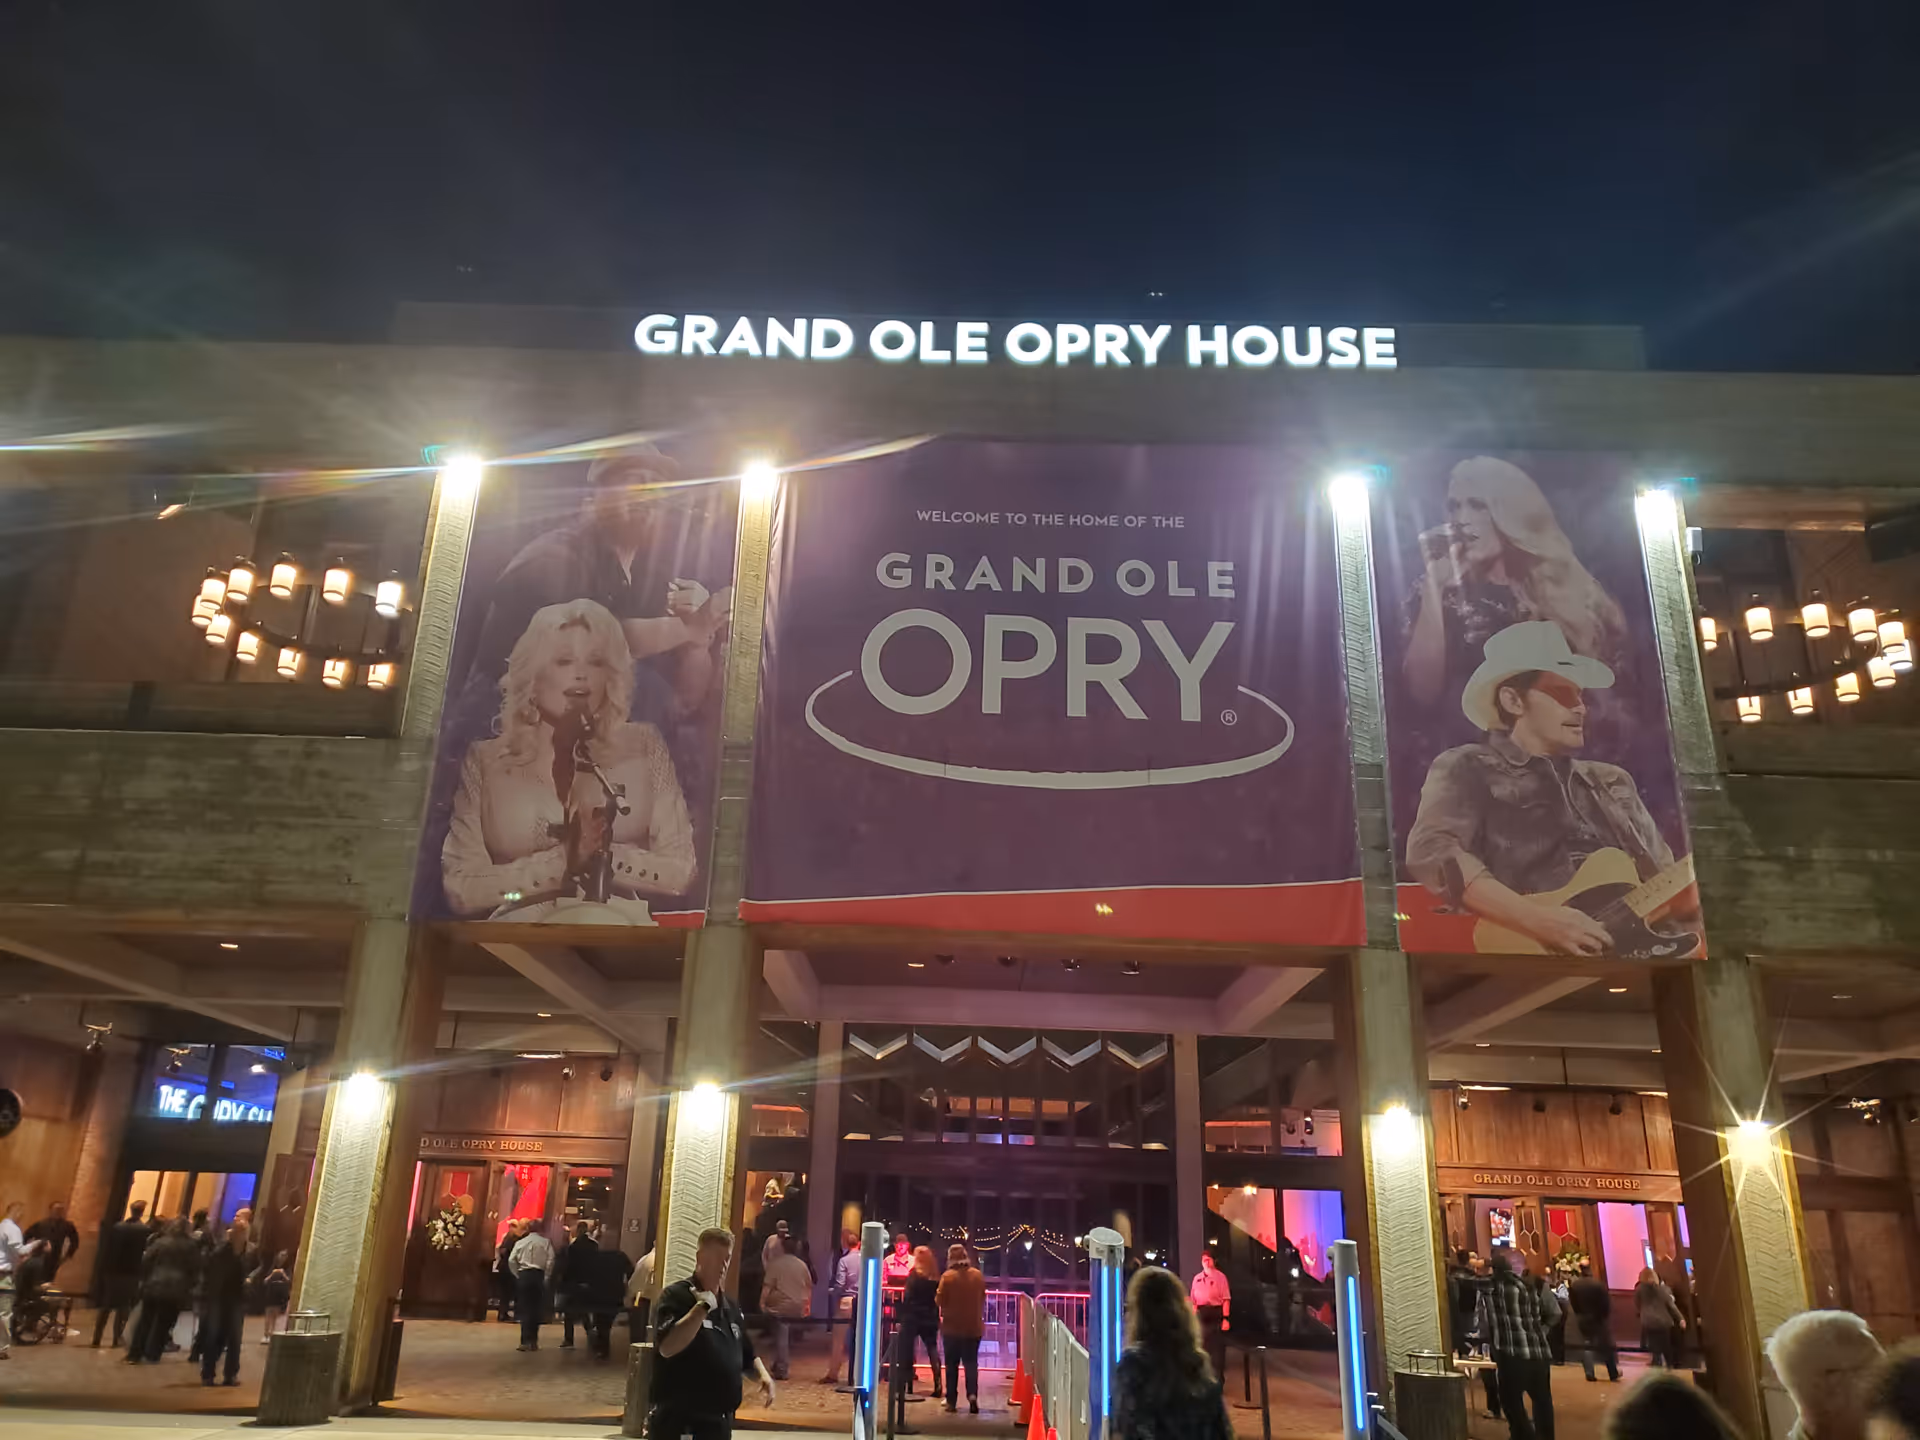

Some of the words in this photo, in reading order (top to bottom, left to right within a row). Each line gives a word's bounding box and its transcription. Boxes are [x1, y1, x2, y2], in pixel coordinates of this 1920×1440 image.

[634, 313, 854, 360] GRAND
[869, 319, 990, 364] OLE
[1005, 321, 1172, 367] OPRY
[1187, 324, 1398, 369] HOUSE
[916, 509, 1000, 525] WELCOME
[1005, 512, 1027, 526] TO
[1032, 513, 1064, 526] THE
[1069, 513, 1120, 528] HOME
[1124, 515, 1148, 528] OF
[1152, 515, 1185, 529] THE
[875, 552, 1095, 594] GRAND
[1116, 559, 1236, 599] OLE
[860, 608, 1237, 723] OPRY
[159, 1085, 188, 1114] THE
[461, 1139, 496, 1151] OPRY
[499, 1140, 544, 1152] HOUSE
[1473, 1173, 1522, 1185] GRAND
[1526, 1174, 1553, 1187] OLE
[1556, 1176, 1591, 1188] OPRY
[1595, 1177, 1642, 1191] HOUSE
